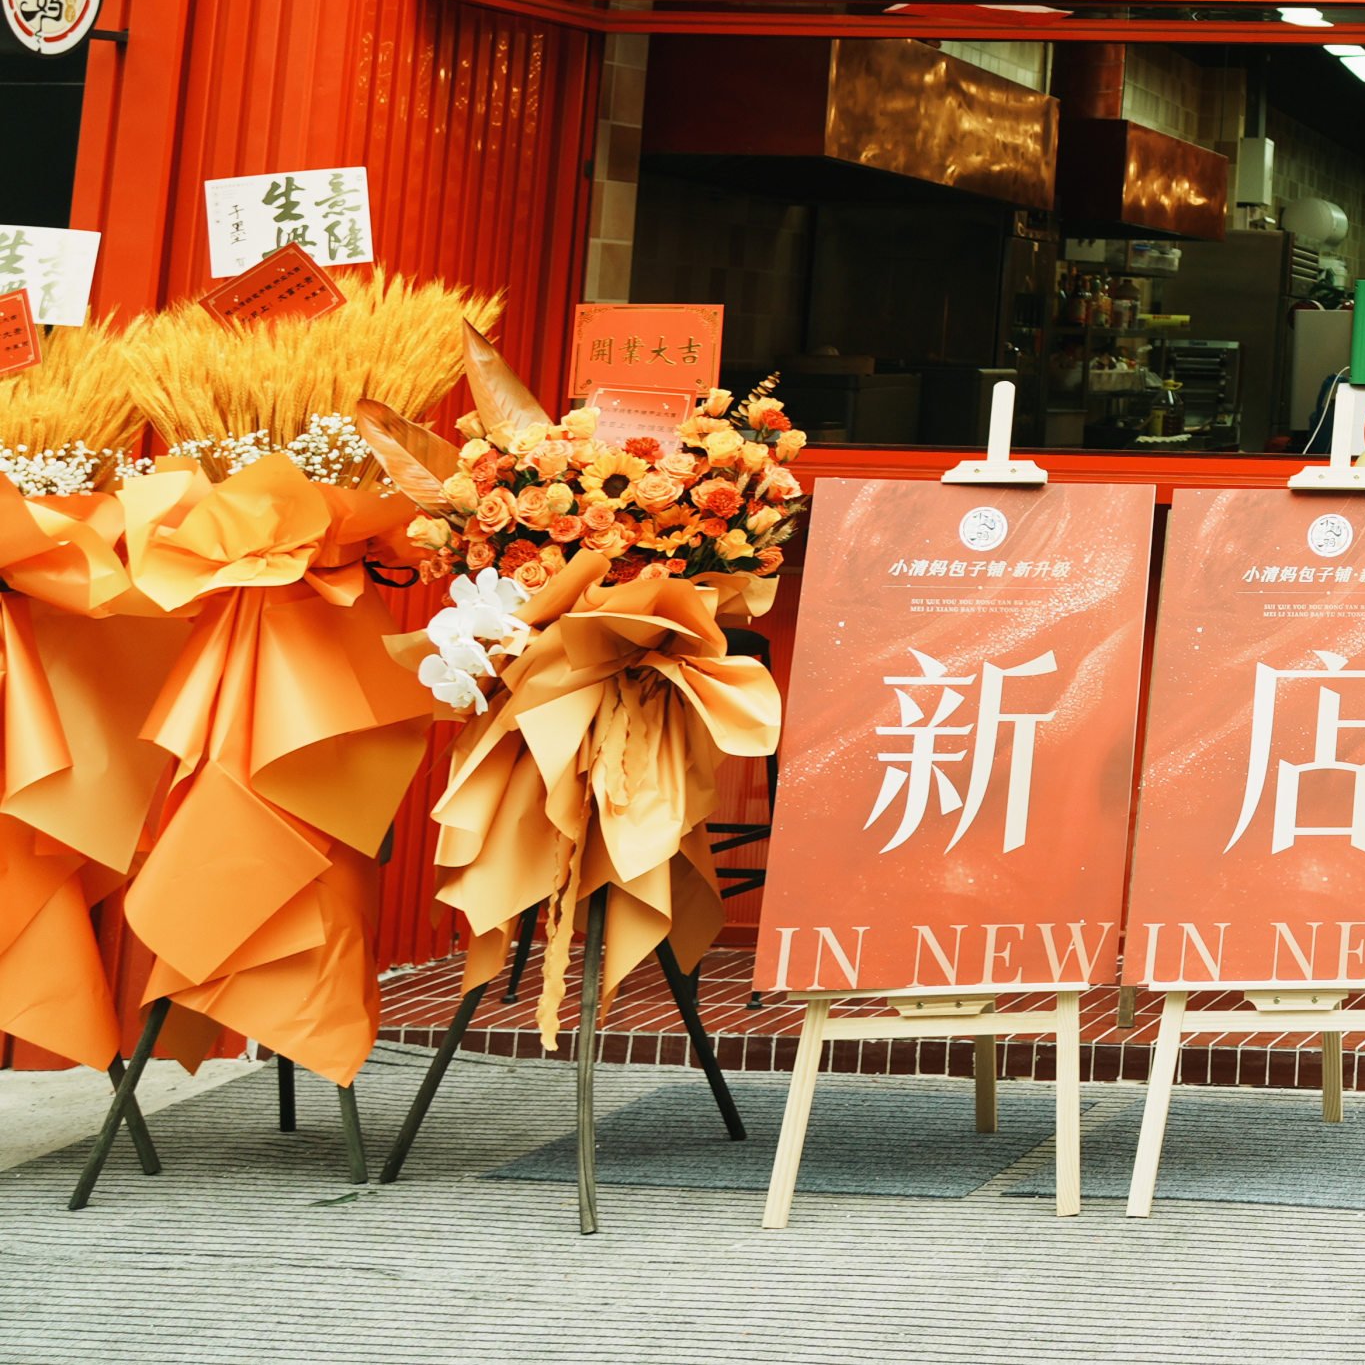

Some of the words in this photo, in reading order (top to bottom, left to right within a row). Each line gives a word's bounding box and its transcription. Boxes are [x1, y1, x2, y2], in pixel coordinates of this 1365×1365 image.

[589, 335, 702, 365] 開業大吉
[863, 647, 1059, 856] 新
[768, 925, 872, 992] IN
[907, 920, 1115, 989] NEW
[1137, 922, 1248, 985] IN
